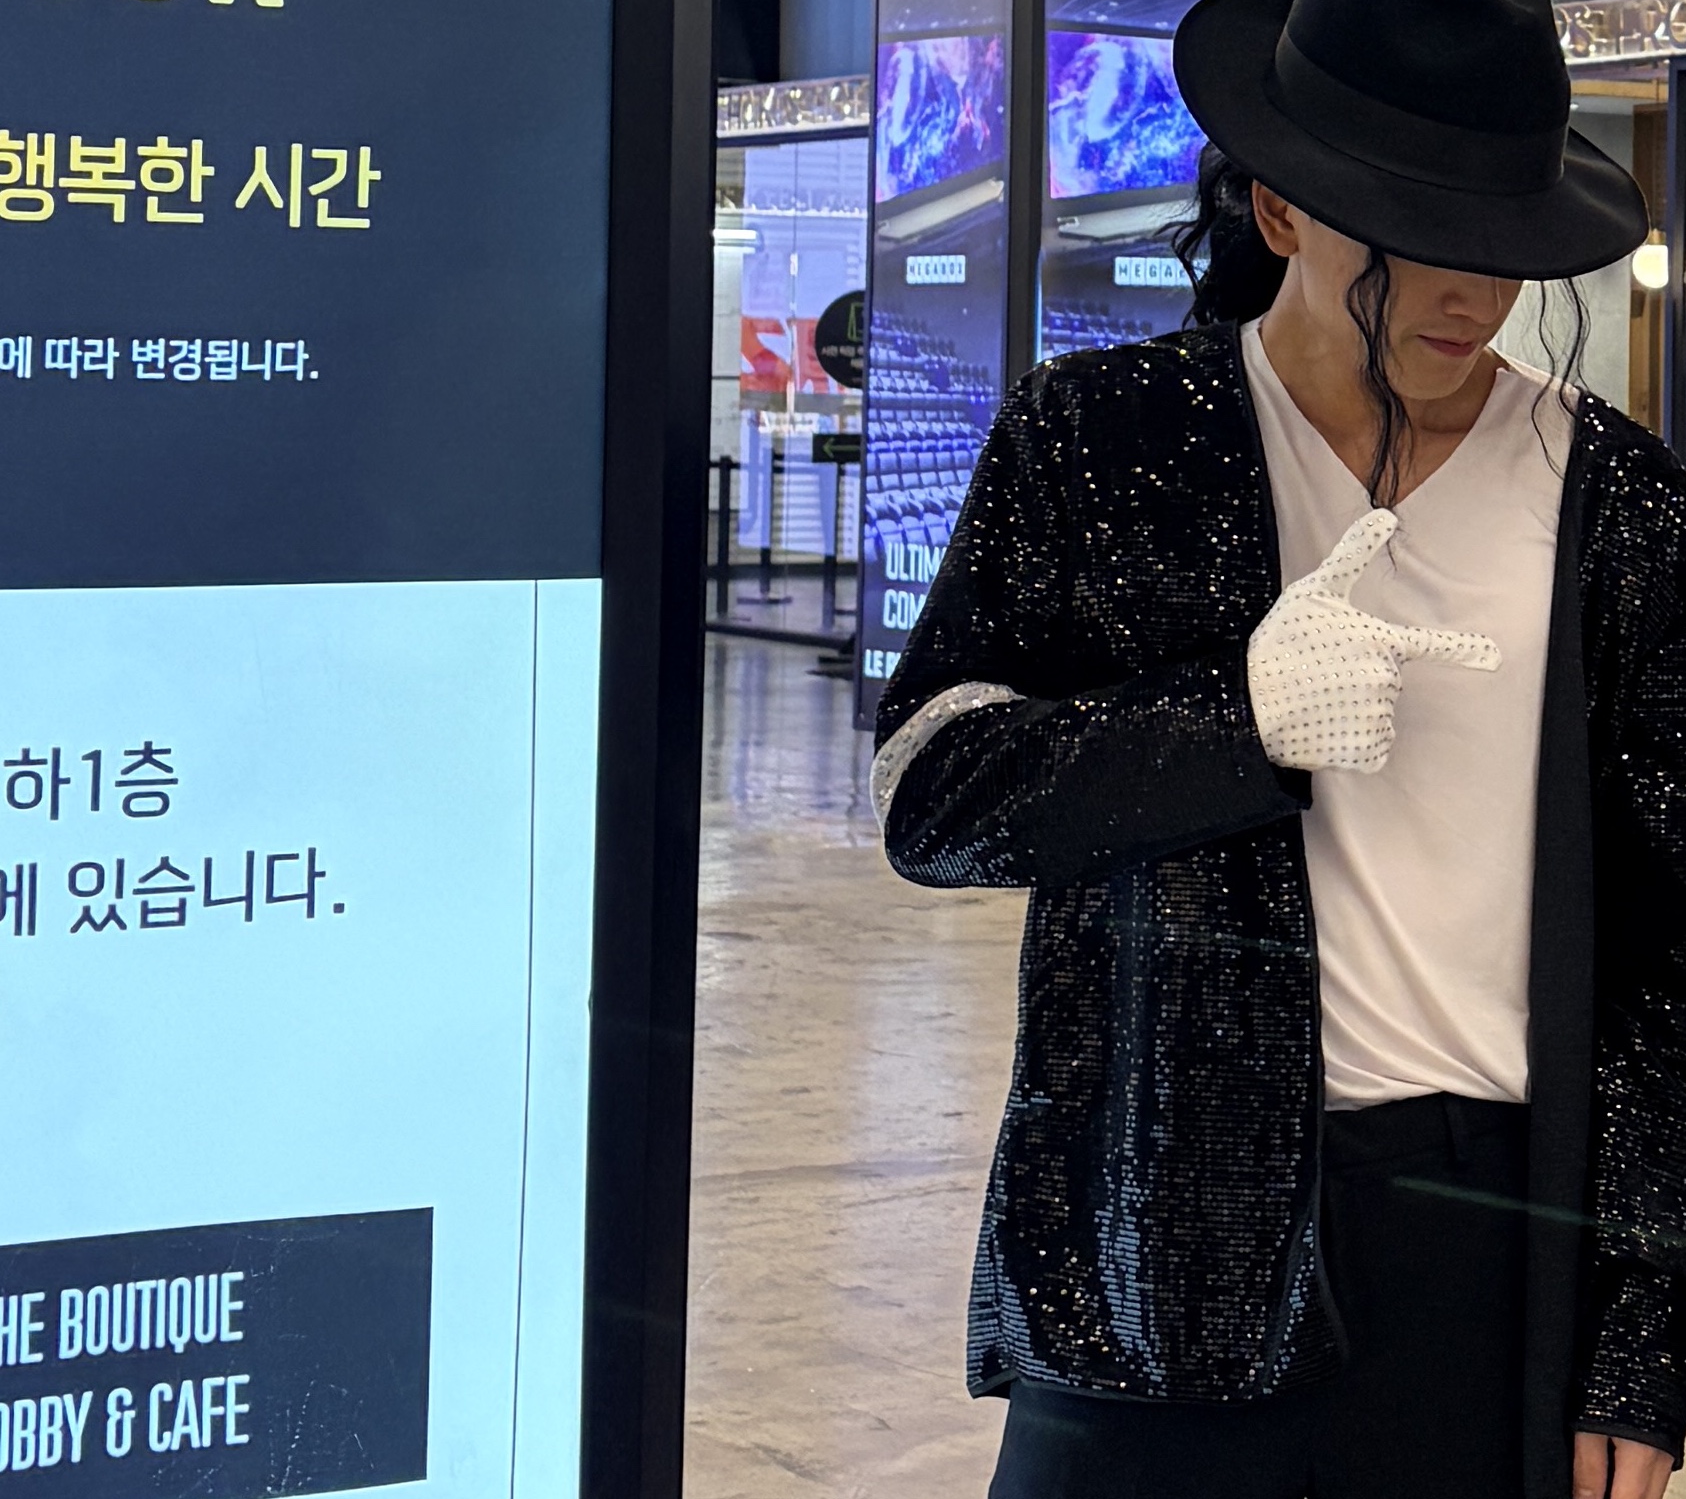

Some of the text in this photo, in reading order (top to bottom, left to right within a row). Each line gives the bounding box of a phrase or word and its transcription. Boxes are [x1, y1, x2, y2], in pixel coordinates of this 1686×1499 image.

[0, 129, 382, 229] 행복한 시간
[45, 337, 120, 380] 따라
[131, 338, 319, 381] 변경됩니다.
[885, 541, 948, 583] ULTIM
[883, 588, 927, 630] COM
[3, 741, 179, 821] 하1층
[67, 847, 345, 934] 있습니다.
[58, 1271, 244, 1360] BOUTIQUE
[105, 1387, 136, 1458] &
[148, 1374, 250, 1453] CAFE
